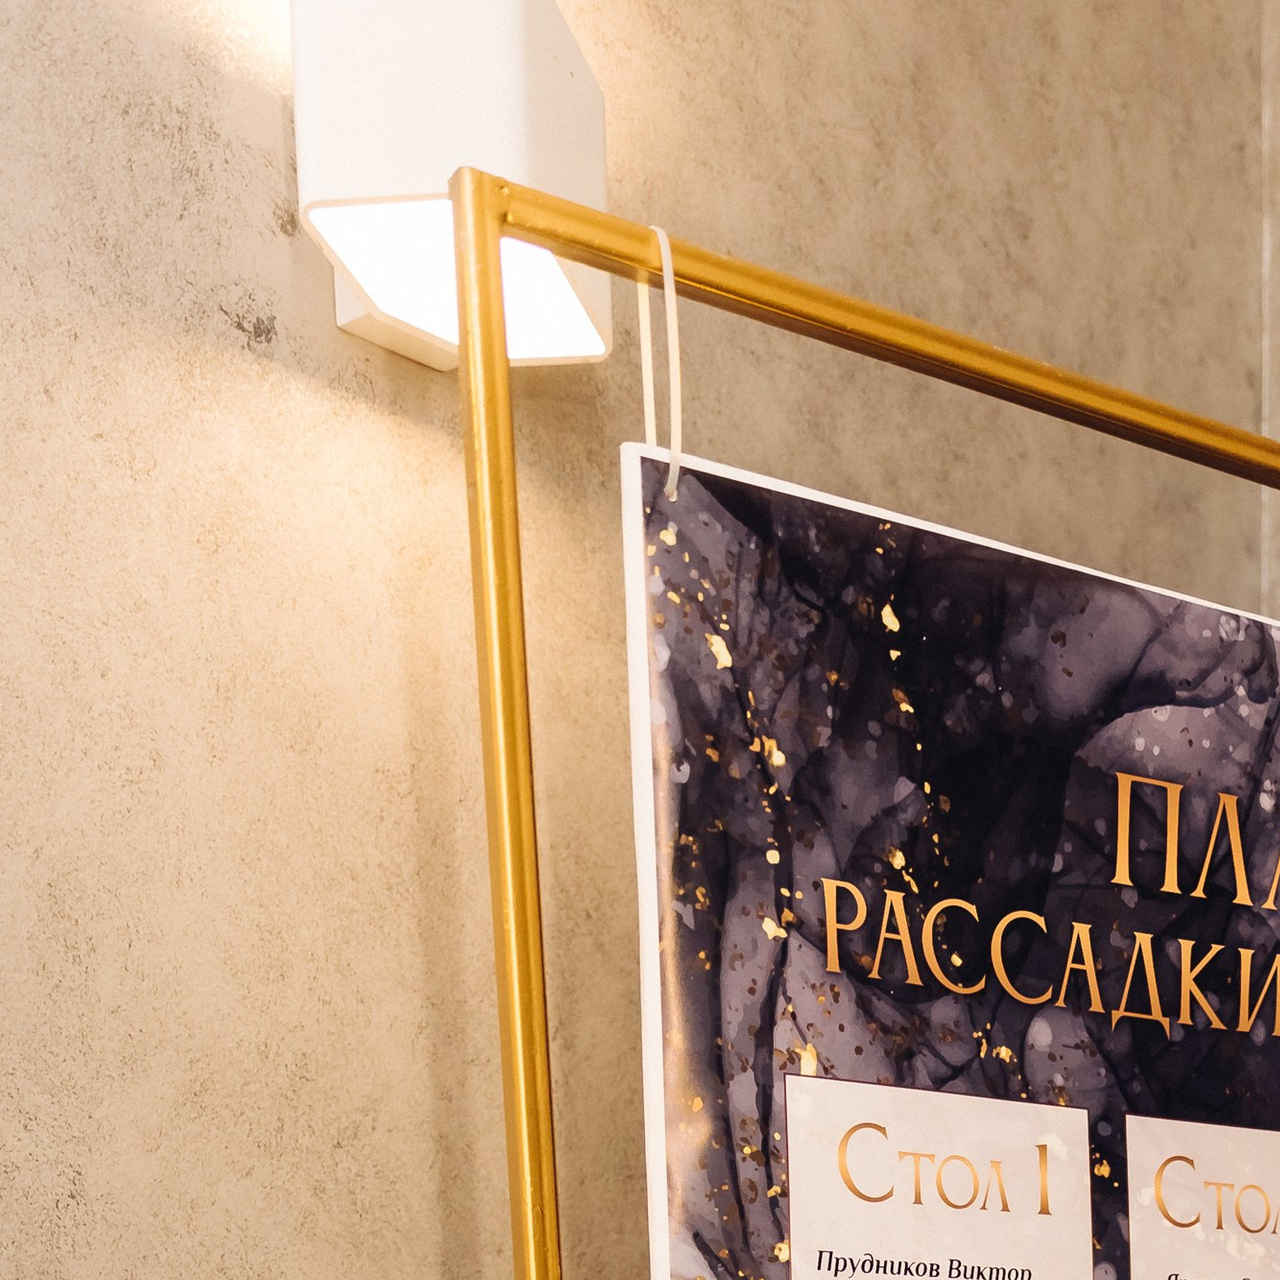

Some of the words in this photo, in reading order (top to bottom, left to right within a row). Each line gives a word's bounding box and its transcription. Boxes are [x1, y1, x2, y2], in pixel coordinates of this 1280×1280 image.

[838, 1122, 1011, 1212] Стол
[1035, 1144, 1052, 1215] 1
[817, 1250, 940, 1278] Прудников
